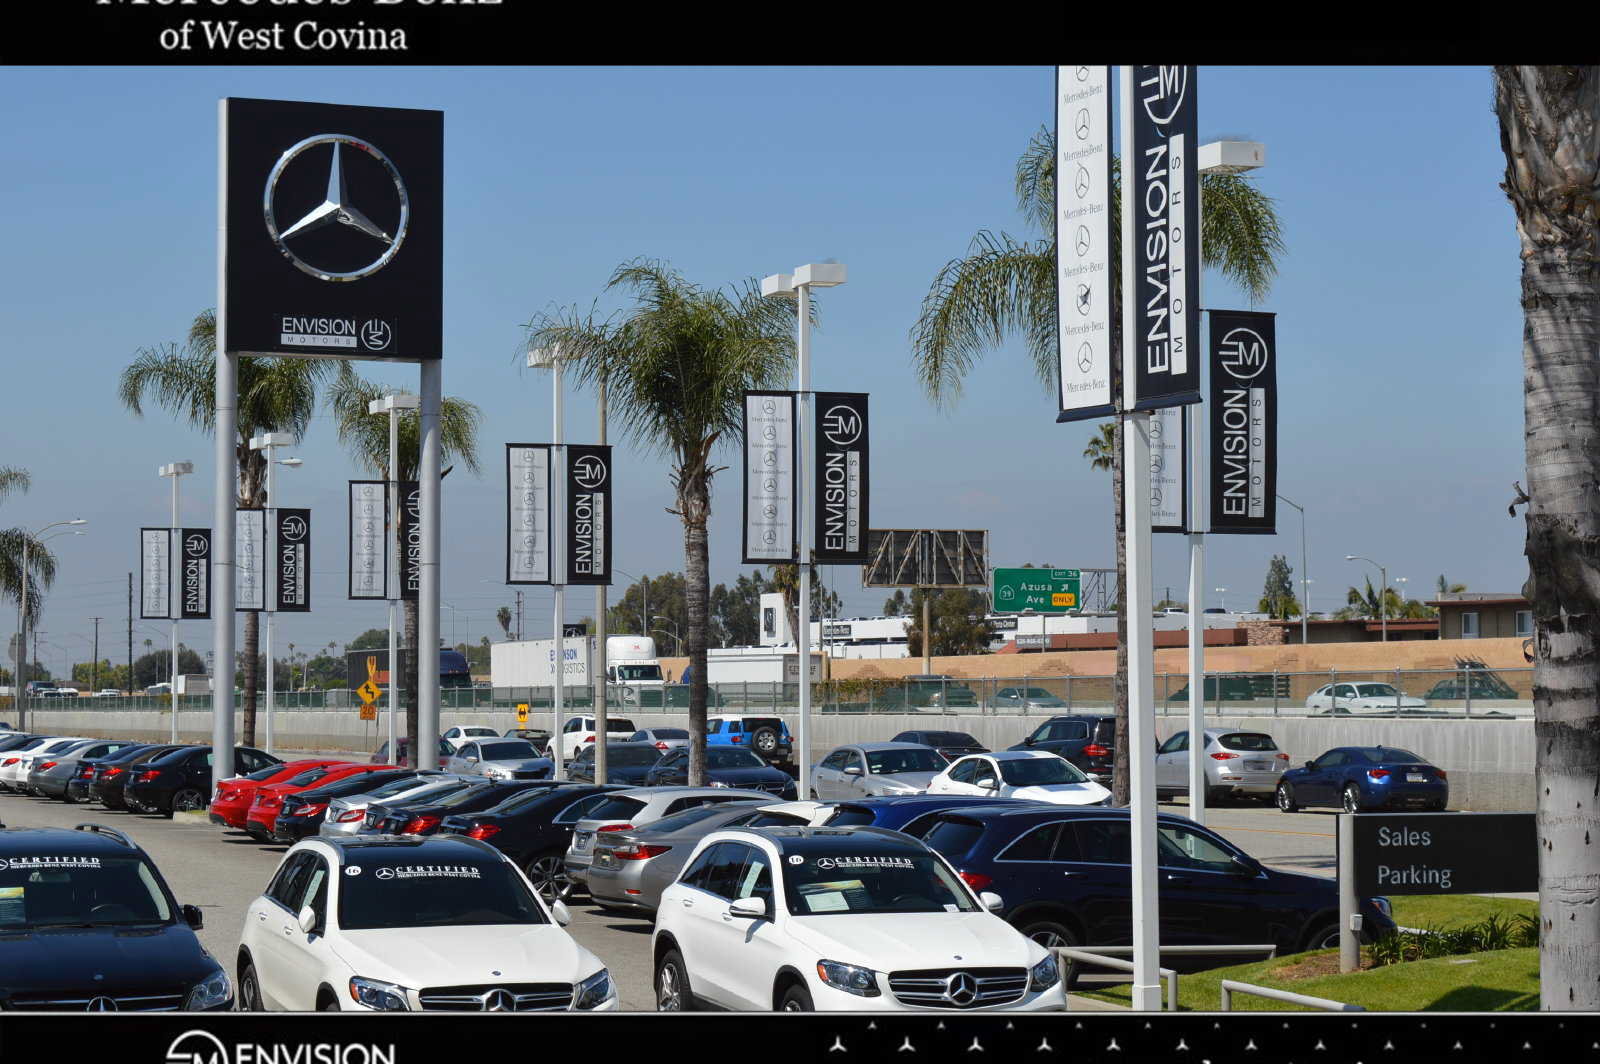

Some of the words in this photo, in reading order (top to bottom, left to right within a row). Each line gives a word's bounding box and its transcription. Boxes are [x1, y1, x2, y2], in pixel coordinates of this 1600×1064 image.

[1146, 145, 1169, 374] ENVISION
[1172, 156, 1183, 353] MOTORS
[282, 317, 356, 335] ENVISION
[287, 336, 351, 345] MOTORS
[1223, 389, 1248, 515] ENVISION
[1252, 399, 1262, 507] MOTORS
[825, 452, 845, 550] ENVISION
[848, 459, 858, 543] MOTORS
[575, 494, 592, 574] ENVISION
[186, 559, 198, 612] ENVISION
[283, 545, 295, 604] ENVISION
[1020, 582, 1053, 591] Azusa
[1026, 595, 1045, 603] Ave
[835, 856, 911, 864] CERTIFIED
[1378, 826, 1431, 846] Sales
[396, 865, 478, 873] CERTIFIED
[1378, 865, 1452, 889] Parking
